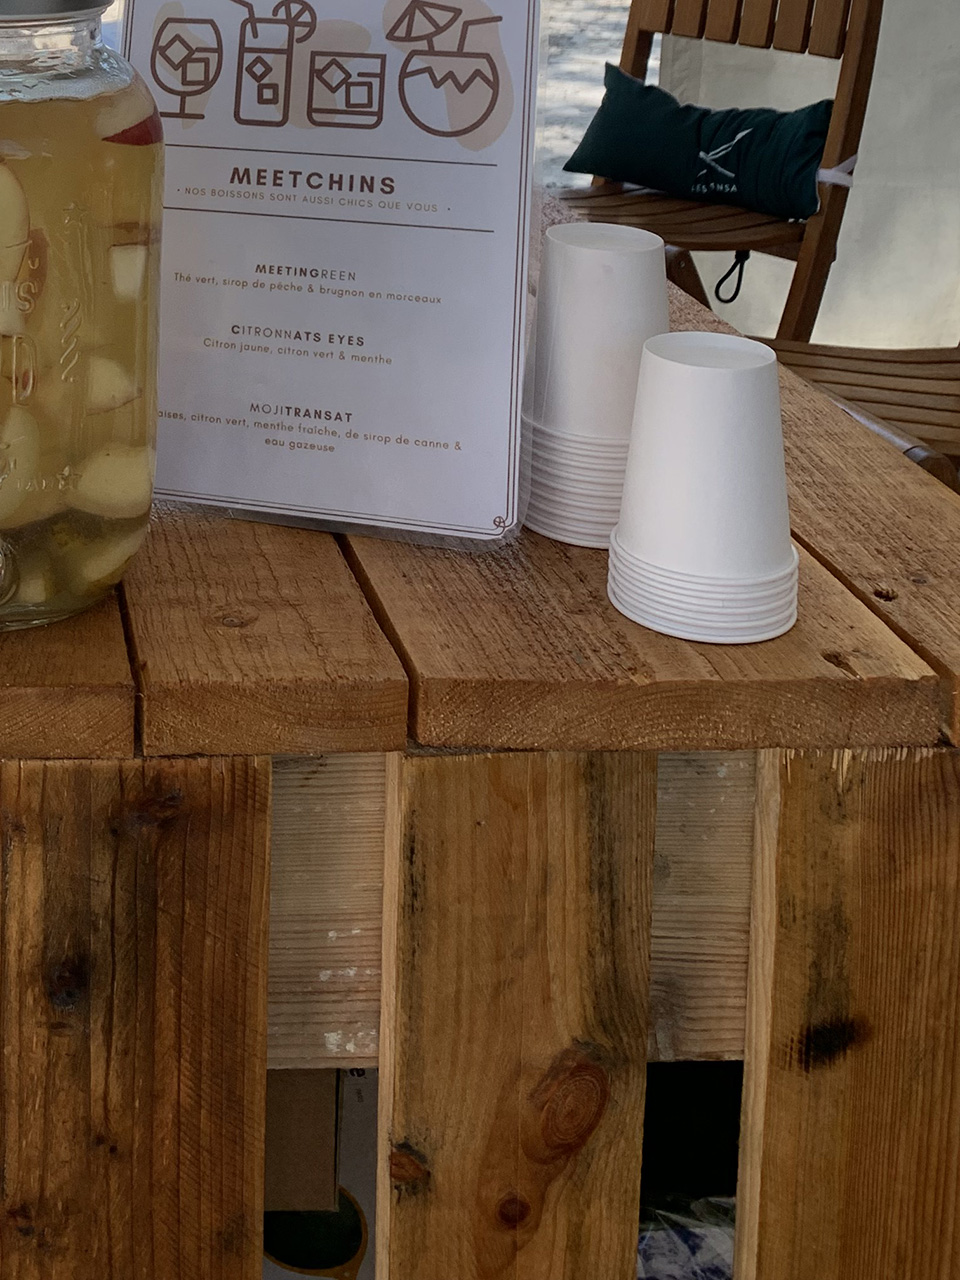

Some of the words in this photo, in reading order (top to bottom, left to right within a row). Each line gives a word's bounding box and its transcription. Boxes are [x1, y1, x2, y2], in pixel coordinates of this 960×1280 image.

[229, 166, 395, 195] MEETCHINS
[184, 187, 207, 196] NOS
[210, 189, 265, 201] BOISSONS
[269, 193, 297, 202] SONT
[302, 195, 334, 205] AUSSI
[338, 197, 374, 208] CHICS
[378, 200, 401, 210] QUE
[406, 202, 438, 212] VOUS
[255, 264, 356, 281] MEETINGREEN
[0, 278, 37, 314] IS
[174, 272, 191, 282] Thé
[195, 276, 218, 286] vert,
[222, 278, 248, 289] sirop
[252, 279, 265, 289] de
[307, 284, 314, 293] &
[320, 285, 365, 298] brugnon
[368, 291, 382, 299] en
[386, 292, 442, 304] morceaux
[231, 324, 322, 343] CITRONNATS
[328, 333, 365, 347] EYES
[203, 337, 237, 350] Citron
[239, 341, 273, 355] jaune,
[277, 345, 309, 357] citron
[313, 350, 334, 359] vert
[338, 351, 346, 361] &
[351, 354, 392, 365] menthe
[249, 402, 353, 423] MOJITRANSAT
[190, 412, 222, 424] citron
[225, 417, 250, 428] vert,
[253, 419, 294, 432] menthe
[345, 428, 359, 439] de
[363, 432, 391, 445] sirop
[395, 434, 410, 445] de
[414, 438, 449, 450] canne
[454, 441, 462, 451] &
[264, 437, 285, 447] eau
[289, 440, 335, 453] gazeuse
